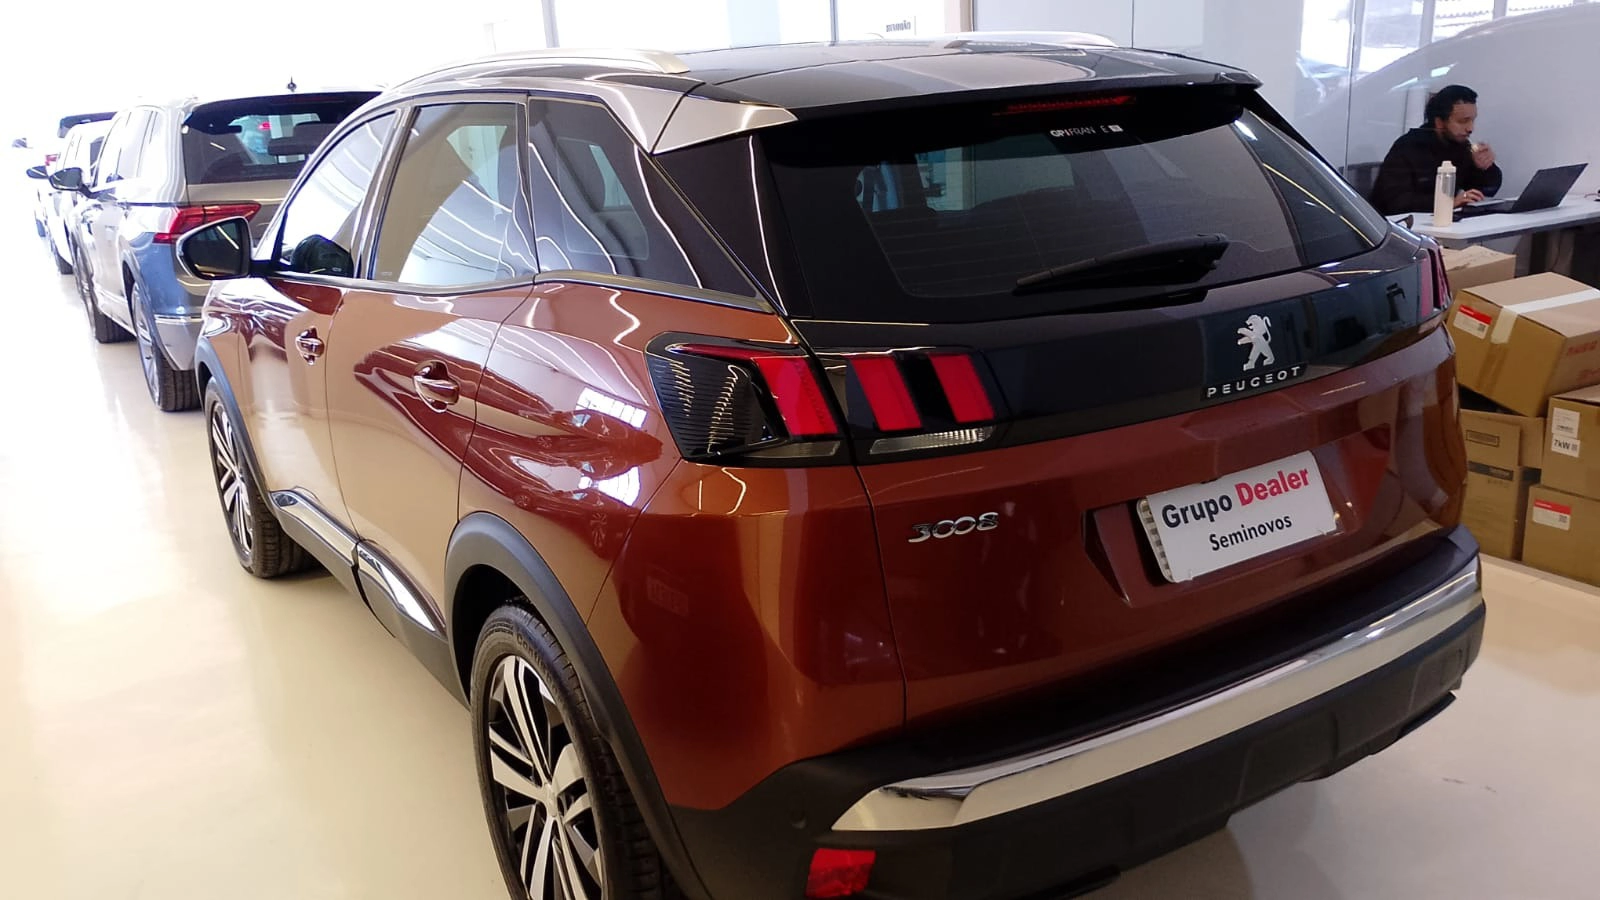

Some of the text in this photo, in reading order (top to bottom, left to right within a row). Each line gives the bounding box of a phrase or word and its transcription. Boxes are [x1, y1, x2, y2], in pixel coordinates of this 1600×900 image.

[1207, 366, 1300, 398] PEUGEOT
[1161, 468, 1309, 528] Grupo Dealer
[908, 512, 999, 543] 3008
[1209, 515, 1292, 551] Seminovos
